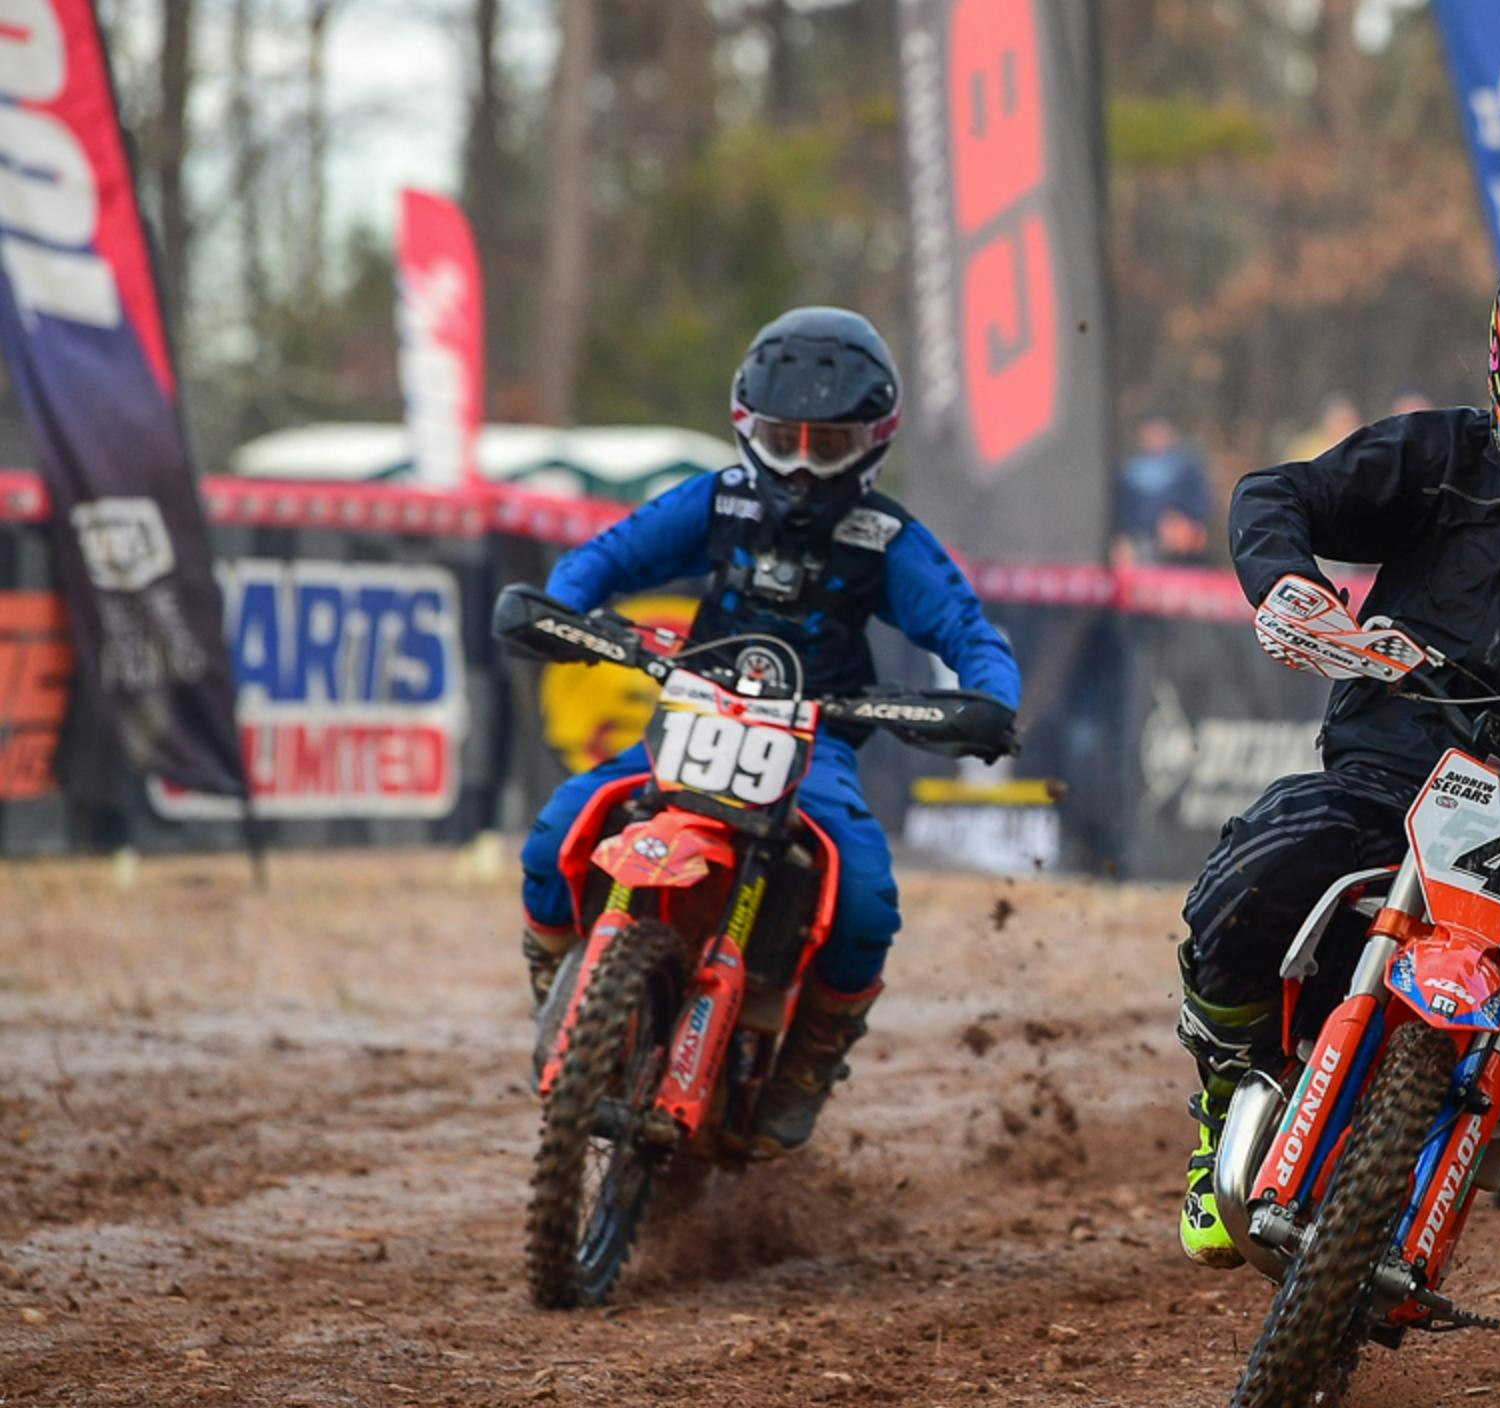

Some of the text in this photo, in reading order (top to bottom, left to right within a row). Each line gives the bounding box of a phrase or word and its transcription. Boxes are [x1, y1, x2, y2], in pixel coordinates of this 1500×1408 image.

[230, 582, 447, 703] ARTS
[534, 617, 627, 661] ACERBIS
[853, 702, 945, 722] ACERBIS
[243, 723, 448, 796] LIMITED
[654, 711, 798, 806] 199
[1444, 771, 1497, 793] ANDREW
[1431, 777, 1493, 806] SEGARS
[1423, 977, 1477, 1006] KTM
[1276, 1045, 1342, 1188] DUNLOP
[1417, 1113, 1484, 1258] DUNLOP
